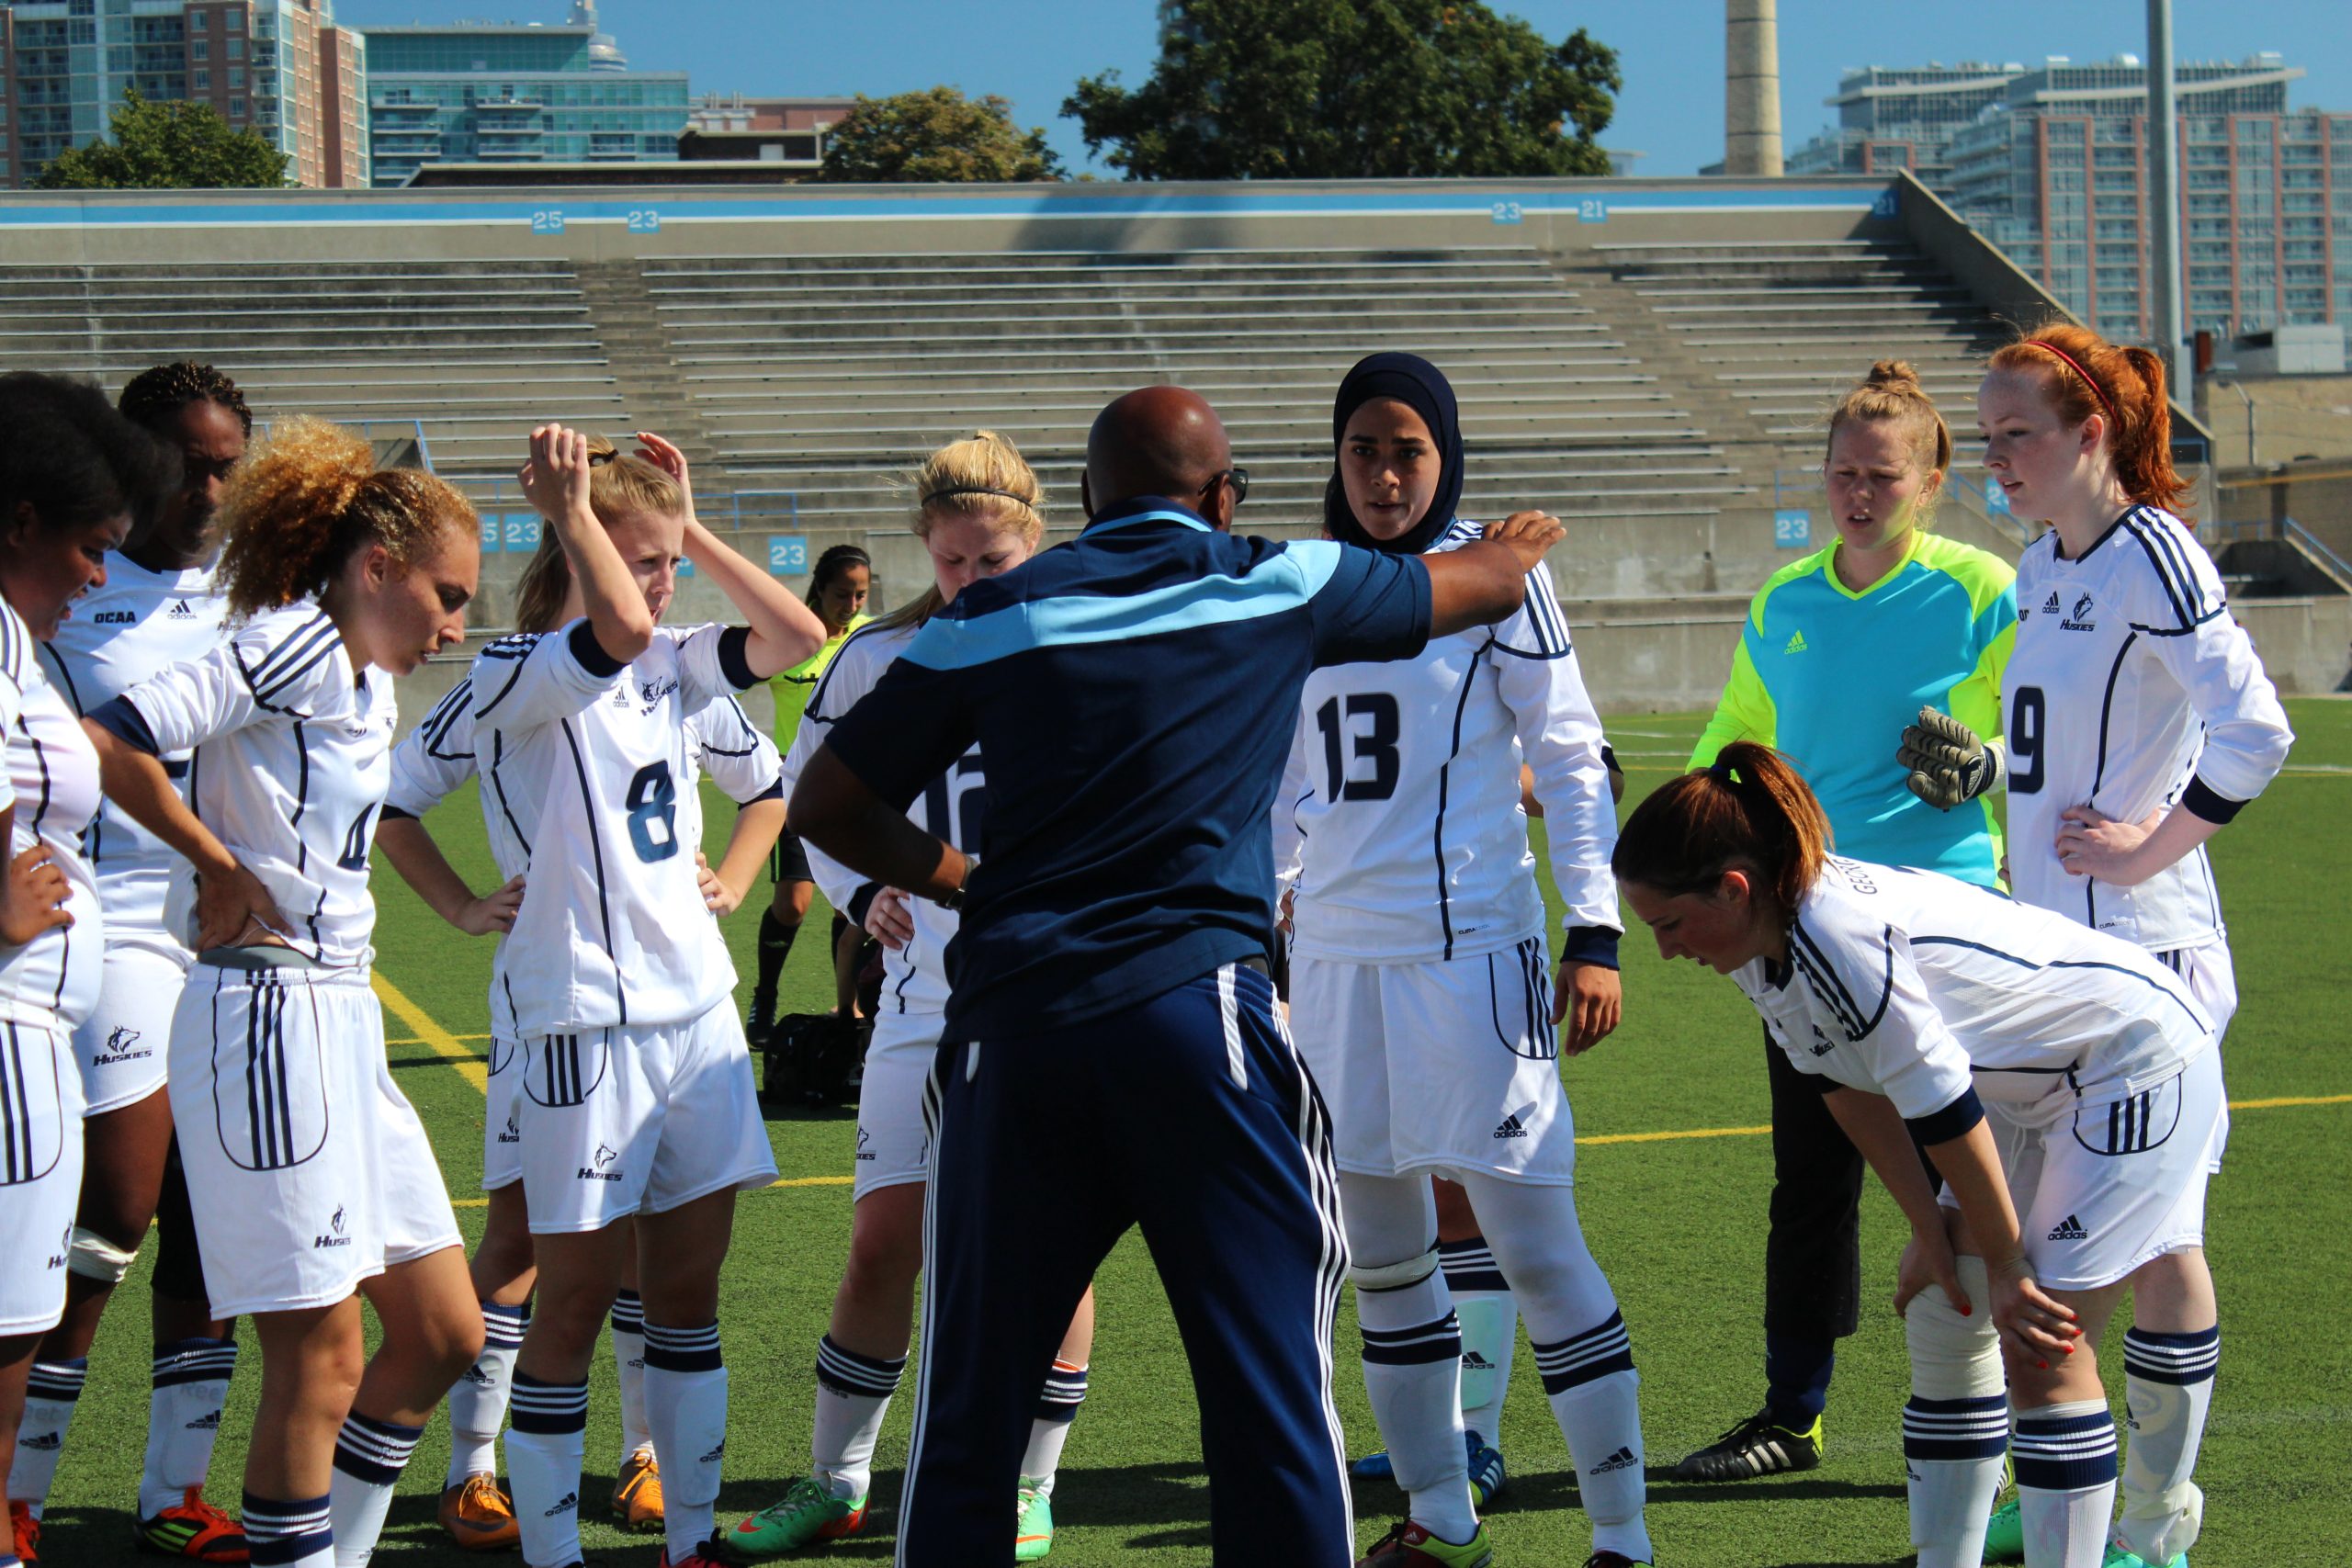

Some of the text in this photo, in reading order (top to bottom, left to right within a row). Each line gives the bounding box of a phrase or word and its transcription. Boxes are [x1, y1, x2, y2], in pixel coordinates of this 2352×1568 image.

[1492, 201, 1522, 220] 23
[1581, 199, 1604, 218] 21
[1875, 197, 1896, 215] 21
[533, 210, 563, 229] 25
[628, 210, 659, 228] 23
[506, 523, 540, 543] 23
[1777, 519, 1808, 539] 23
[771, 545, 805, 566] 23
[95, 611, 137, 624] OCAA
[2060, 618, 2095, 632] HUSKIES
[1316, 691, 1401, 804] 13
[2007, 684, 2045, 795] 9
[626, 760, 678, 863] 8
[93, 1050, 153, 1066] HUSKIES
[1493, 1128, 1527, 1139] adidas
[2048, 1229, 2087, 1241] adidas
[1590, 1457, 1638, 1475] adidas
